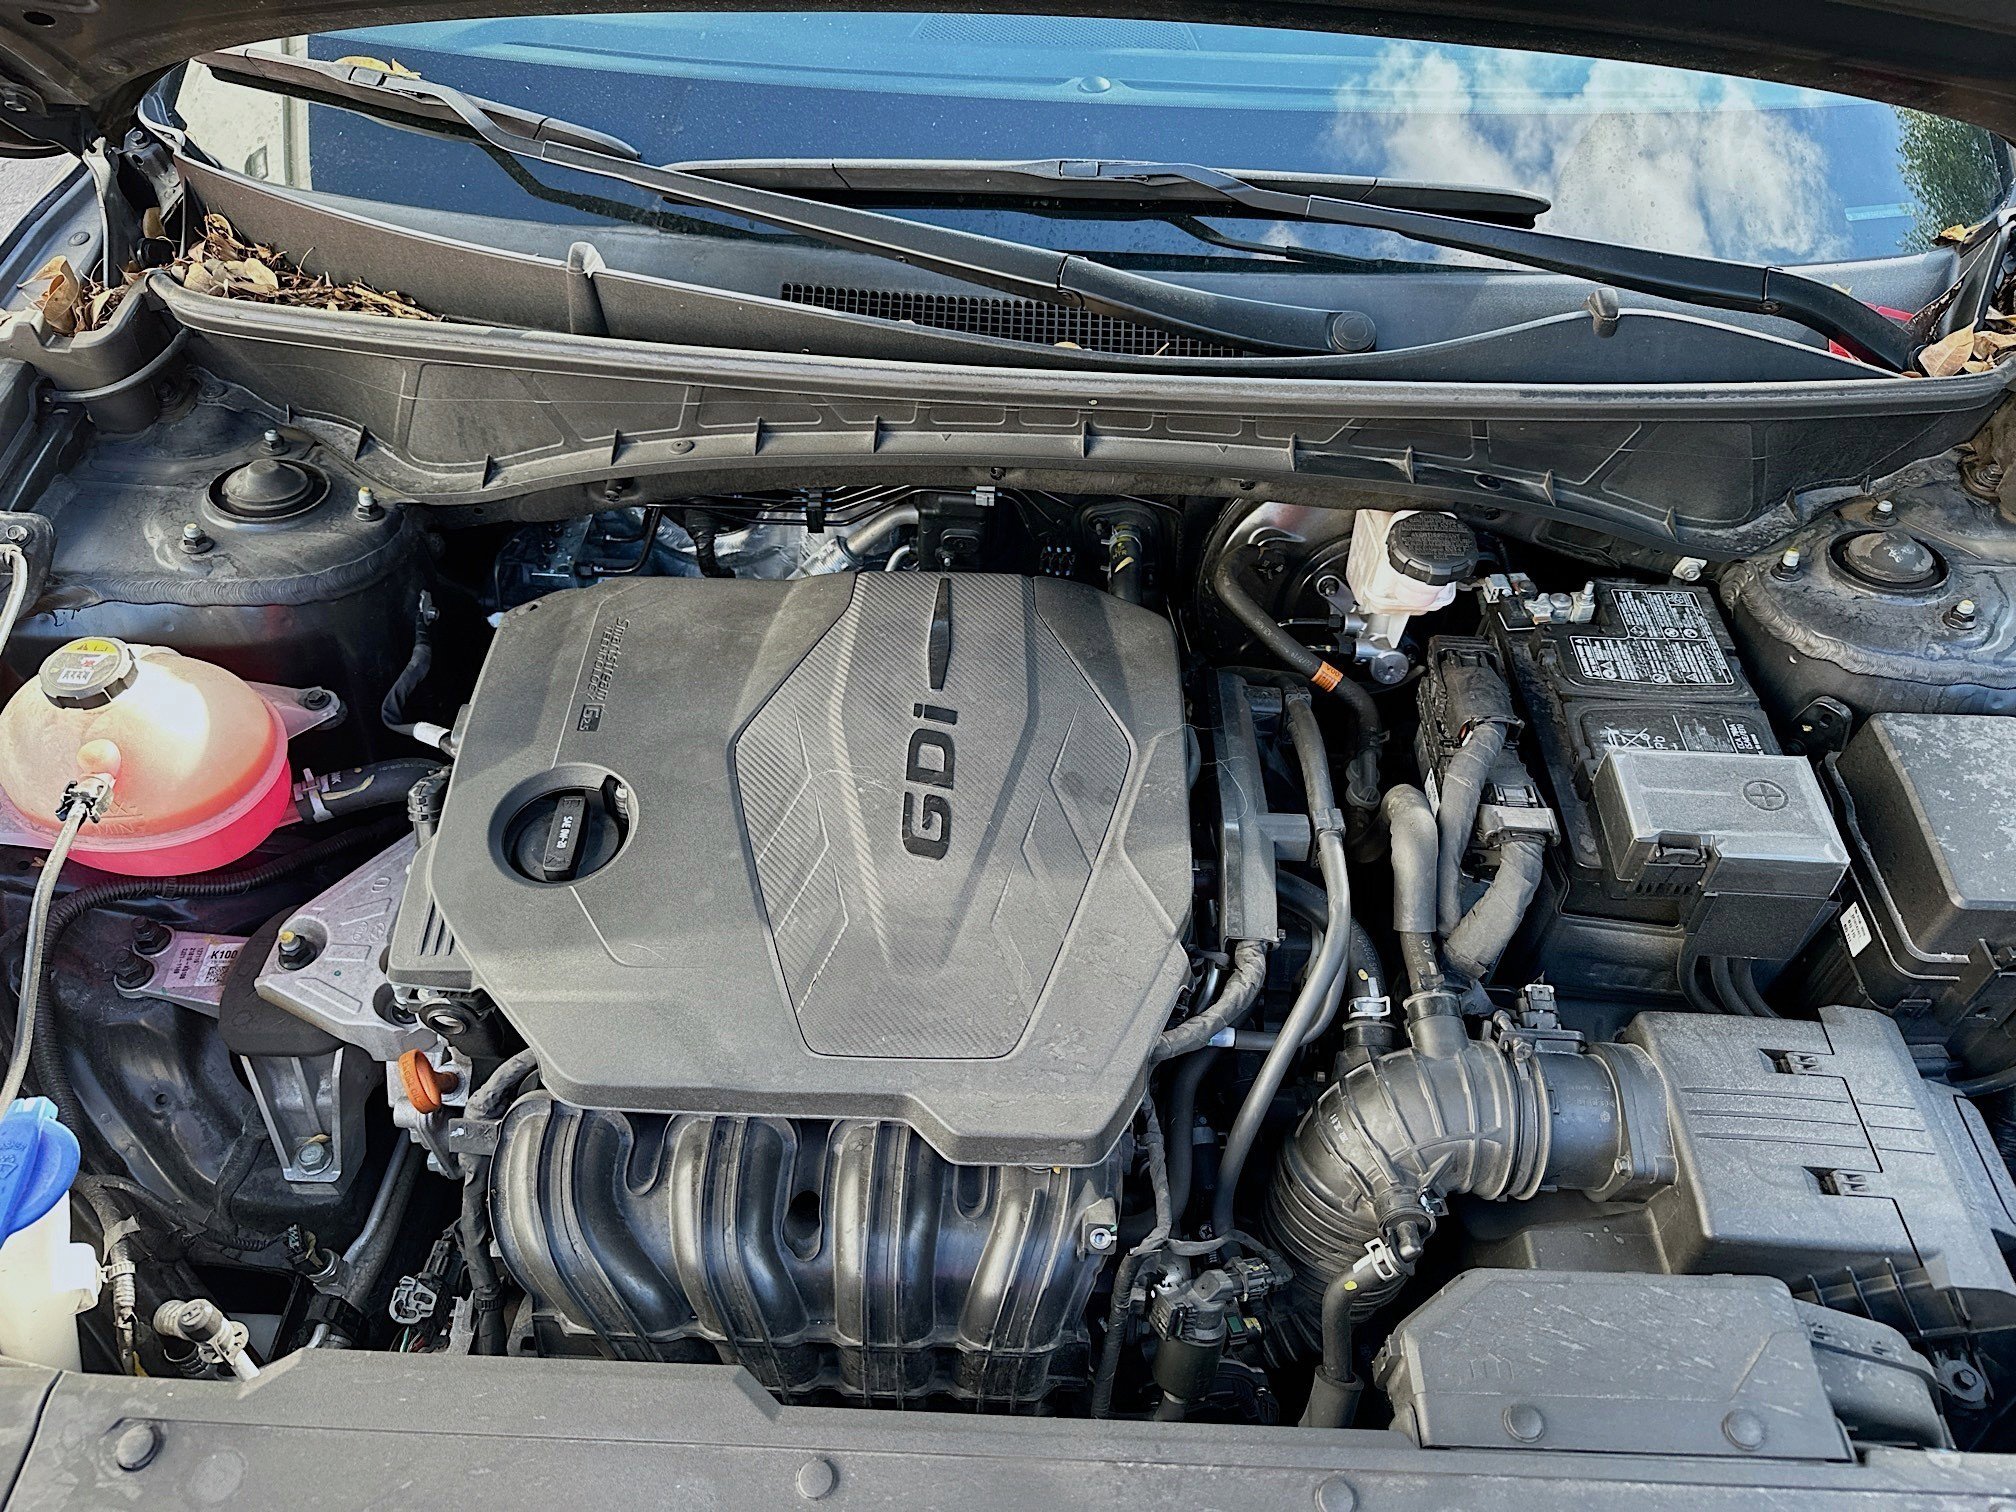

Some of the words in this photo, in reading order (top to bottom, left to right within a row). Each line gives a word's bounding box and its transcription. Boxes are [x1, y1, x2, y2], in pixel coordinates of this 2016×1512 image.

[586, 626, 613, 701] TECHNOLOGY
[596, 616, 630, 701] Smartstream
[1653, 735, 1669, 750] Pb
[901, 702, 959, 861] GDi
[562, 815, 573, 828] SAE
[556, 828, 570, 849] 0W-20
[210, 949, 239, 960] K100
